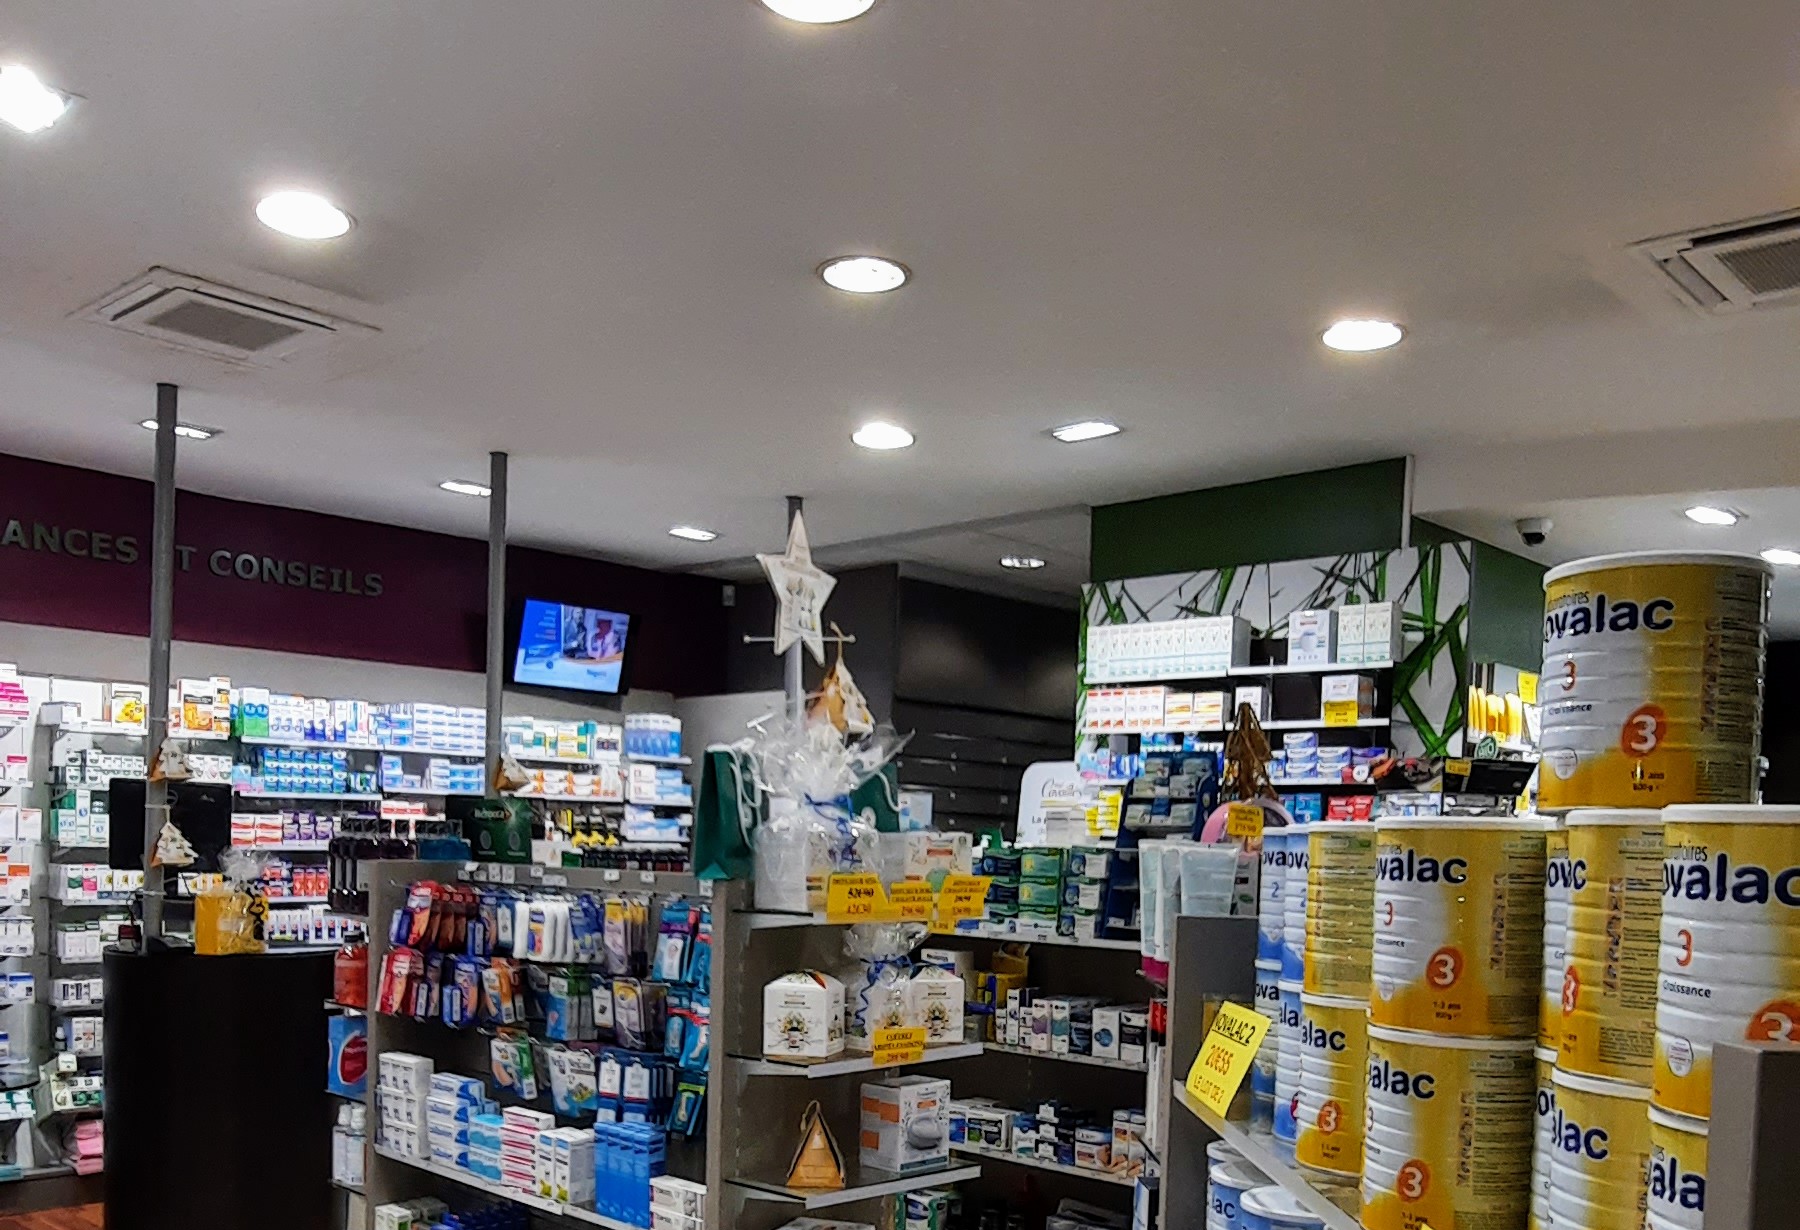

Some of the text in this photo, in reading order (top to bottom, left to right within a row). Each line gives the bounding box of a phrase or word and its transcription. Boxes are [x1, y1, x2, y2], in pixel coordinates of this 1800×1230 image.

[175, 544, 197, 571] T
[208, 549, 384, 598] CONSEILS
[1561, 660, 1576, 692] 3
[1630, 714, 1658, 752] 3
[1270, 881, 1280, 899] 2
[1384, 901, 1394, 926] 3
[1675, 928, 1693, 968] 3
[1433, 953, 1456, 986] 3
[1245, 1025, 1257, 1045] 2
[1324, 1104, 1339, 1133] 3
[1404, 1166, 1424, 1199] 3
